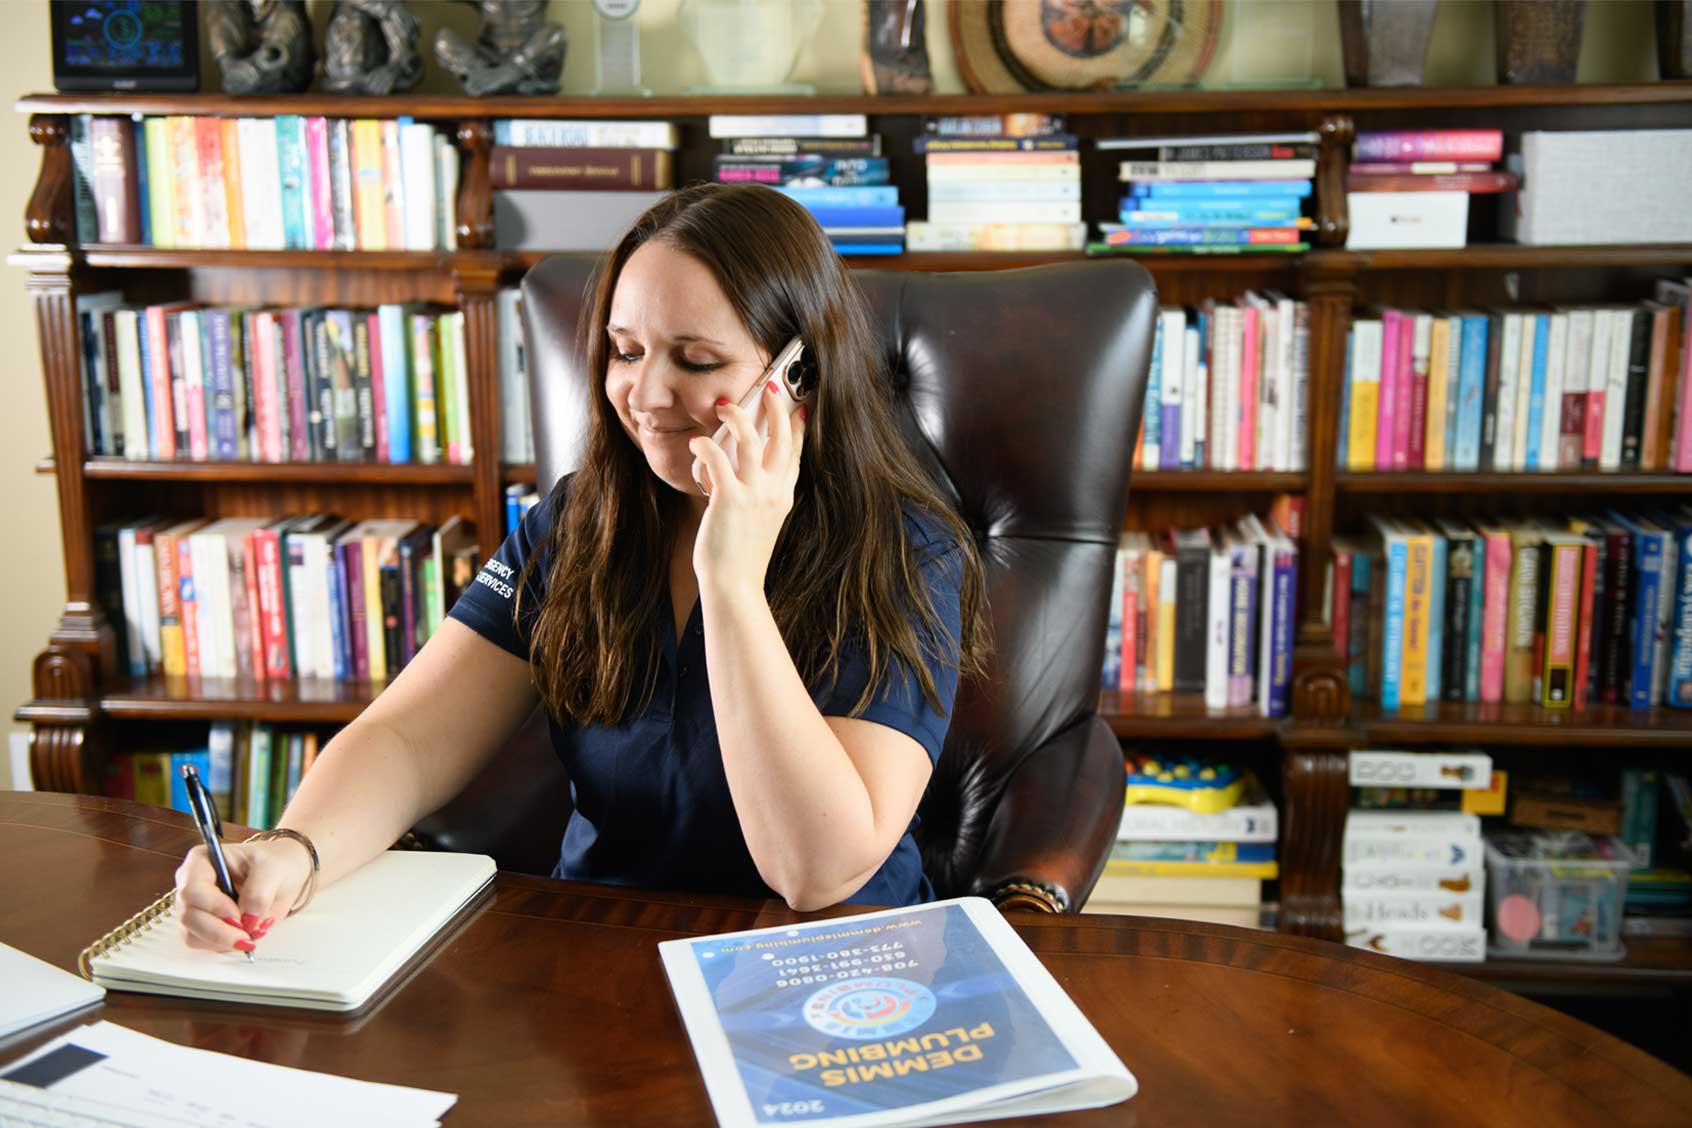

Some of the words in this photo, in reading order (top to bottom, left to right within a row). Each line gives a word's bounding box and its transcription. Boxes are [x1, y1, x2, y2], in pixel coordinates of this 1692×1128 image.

[771, 942, 904, 967] 773-380-1900
[779, 951, 907, 977] 630-991-3641
[775, 959, 919, 988] 708-420-0806
[788, 1022, 995, 1070] PLUMBING
[820, 1044, 984, 1087] DEMMIS
[762, 1099, 826, 1117] 2024
